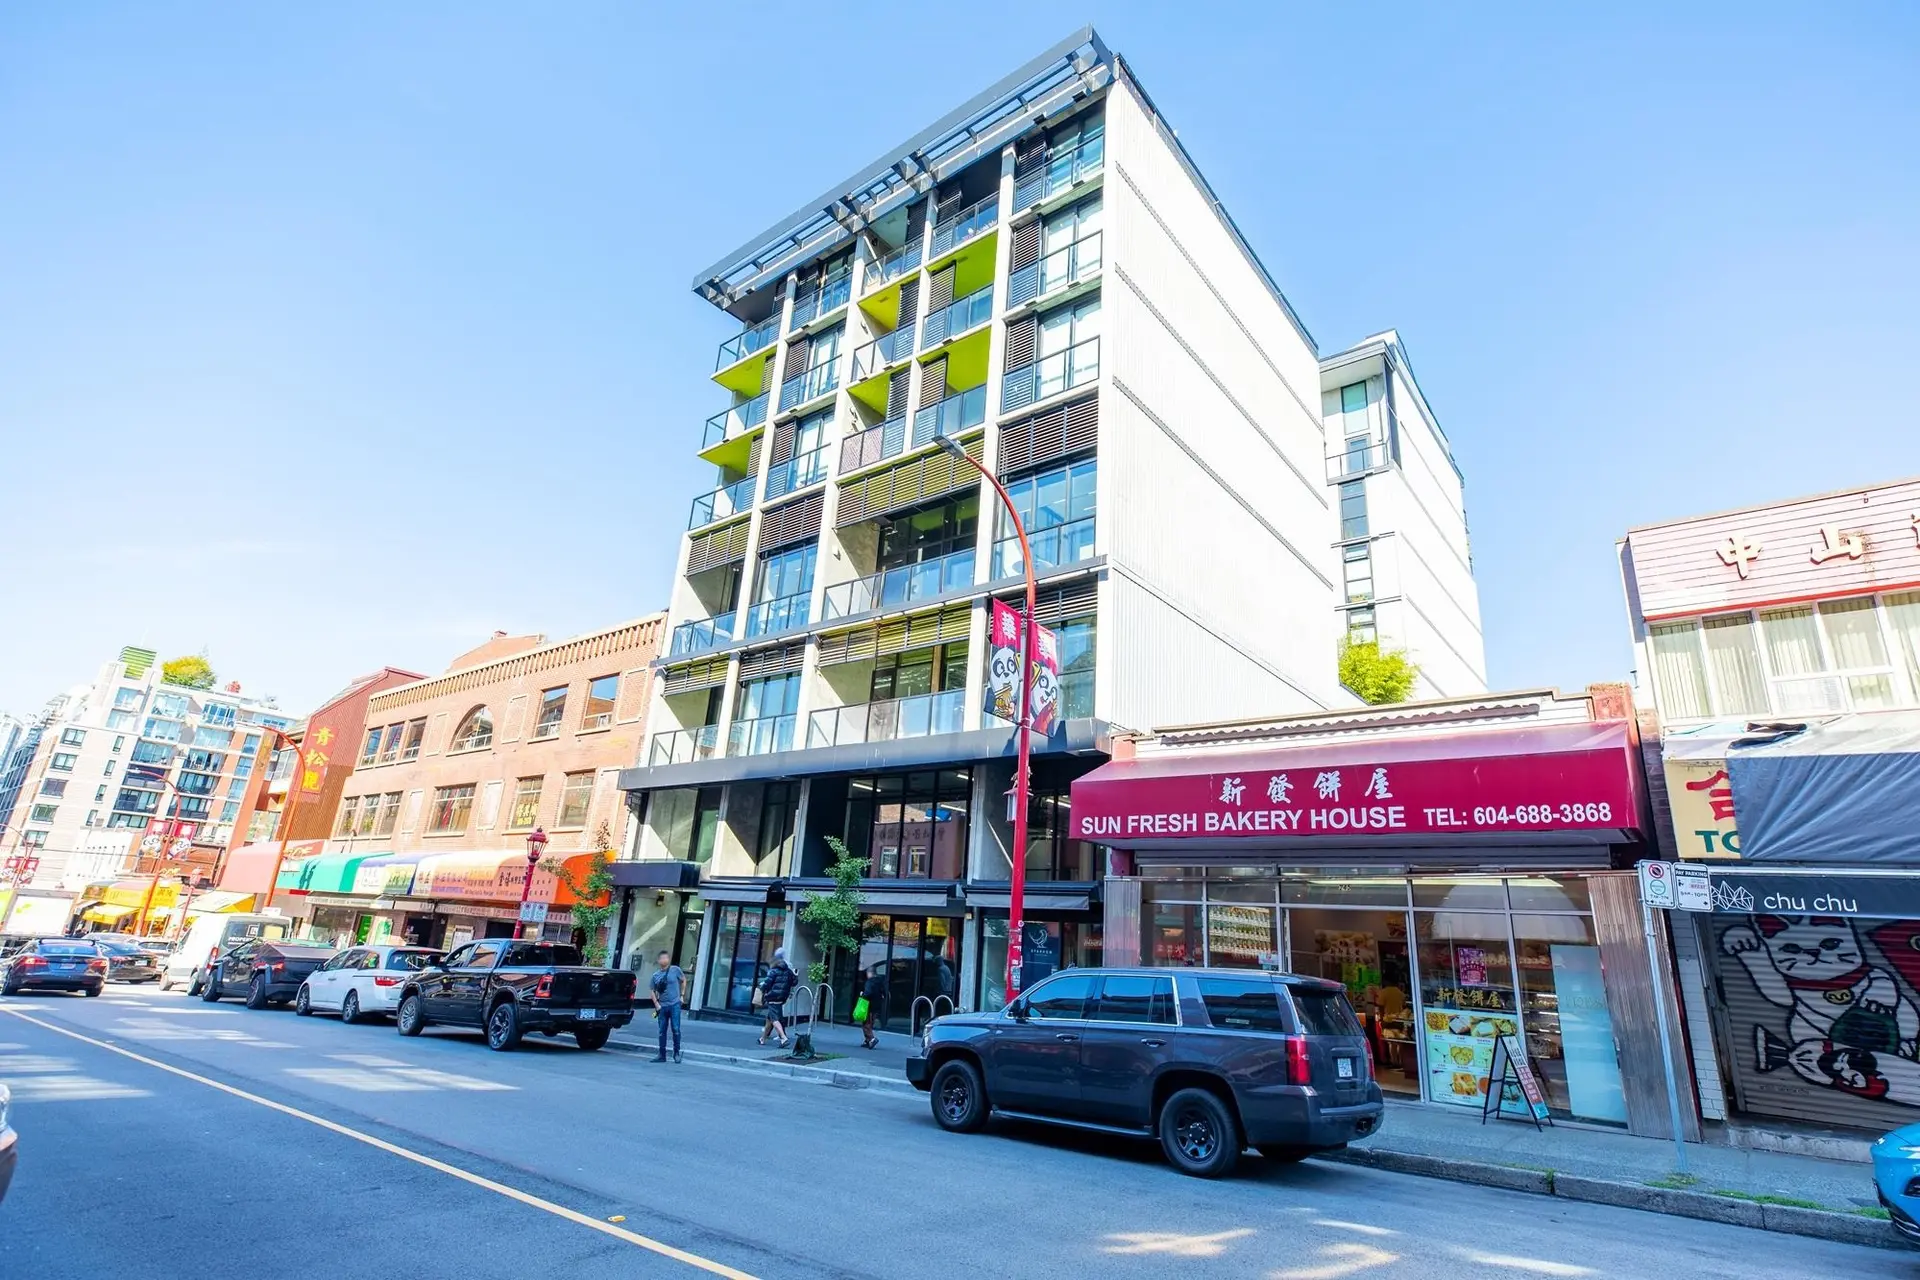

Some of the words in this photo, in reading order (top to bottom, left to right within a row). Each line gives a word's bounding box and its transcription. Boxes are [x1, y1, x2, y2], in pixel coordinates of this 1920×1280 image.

[1081, 816, 1121, 835] SUN
[1127, 813, 1197, 833] FRESH
[1204, 809, 1303, 832] BAKERY
[1310, 806, 1406, 829] HOUSE
[1423, 808, 1467, 826] TEL:
[1474, 802, 1611, 825] 604-688-3868
[1764, 892, 1805, 911] chu
[1813, 894, 1857, 912] chu
